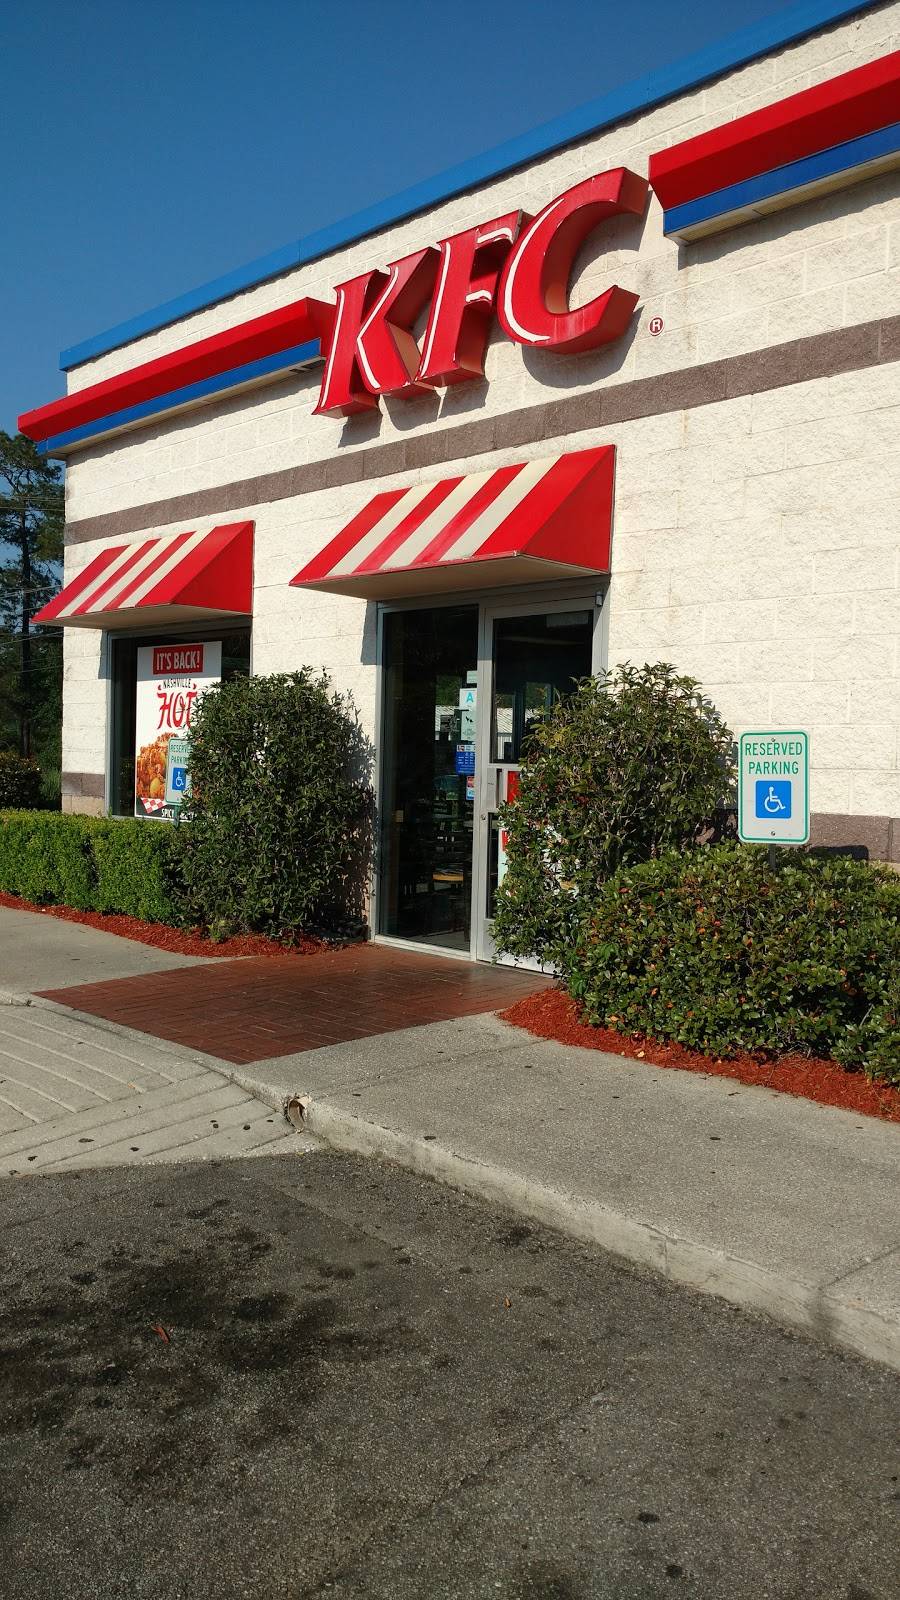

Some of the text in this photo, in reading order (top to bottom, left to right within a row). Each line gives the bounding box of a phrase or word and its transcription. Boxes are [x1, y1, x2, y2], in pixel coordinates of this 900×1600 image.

[312, 167, 648, 415] KFC
[156, 650, 200, 671] IT'S BACK!
[163, 678, 192, 689] NASHVILLE
[156, 691, 198, 730] HOT
[745, 742, 803, 756] RESERVED
[748, 761, 799, 775] PARKING
